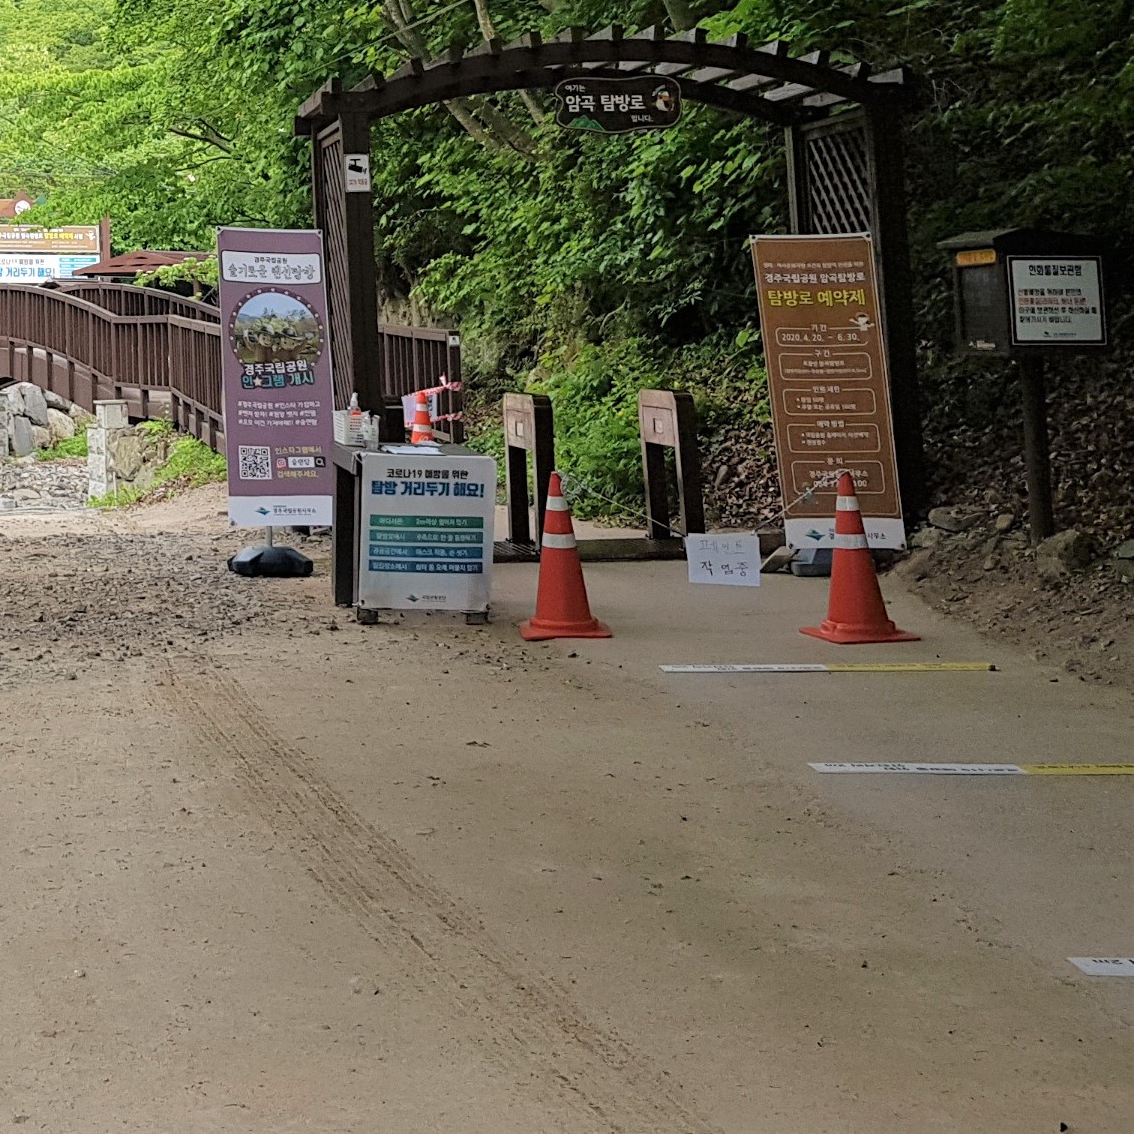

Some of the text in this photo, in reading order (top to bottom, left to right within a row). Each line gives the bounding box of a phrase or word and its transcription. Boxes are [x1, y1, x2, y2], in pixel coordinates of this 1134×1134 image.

[564, 84, 586, 93] 여기는
[565, 94, 646, 113] 암곡 탐방로
[254, 256, 288, 264] 경주국립공원
[6, 266, 35, 277] 거리두기
[37, 266, 55, 277] 해요!
[228, 263, 267, 278] 슬기로운
[1028, 265, 1082, 276] 인화물질보관함
[764, 272, 866, 284] 경주국립공원 암곡탐방로
[767, 288, 866, 307] 탐방로 예약제
[244, 359, 308, 376] 경주국립공원
[289, 371, 314, 385] 개시
[275, 446, 322, 455] 인스타그램에서
[386, 468, 469, 480] 코로나19 예방을 위한
[371, 480, 485, 498] 탐방 거리두기 해요!
